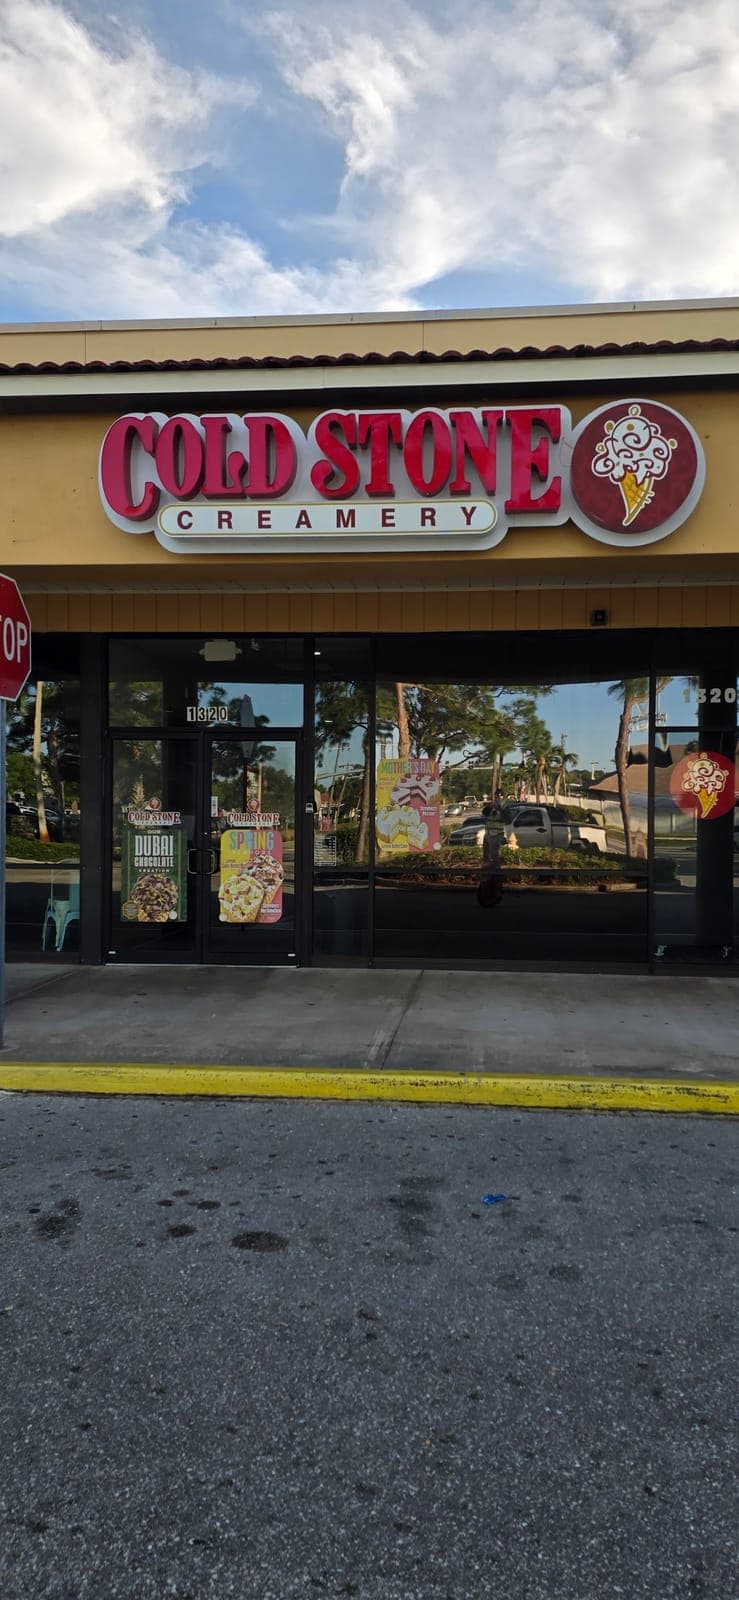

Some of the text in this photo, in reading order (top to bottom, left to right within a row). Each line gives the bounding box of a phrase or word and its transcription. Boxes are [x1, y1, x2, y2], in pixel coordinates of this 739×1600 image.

[101, 406, 562, 521] COLD STONE
[176, 506, 478, 530] CREAMERY
[0, 615, 28, 663] OP
[683, 688, 736, 703] 1320
[188, 706, 227, 721] 1320
[128, 811, 181, 824] COLD STONE
[228, 813, 250, 824] COLD
[251, 813, 280, 824] STONE
[135, 835, 174, 856] DUBAI
[230, 831, 275, 850] SPRING
[134, 857, 175, 867] CHOCOLATE
